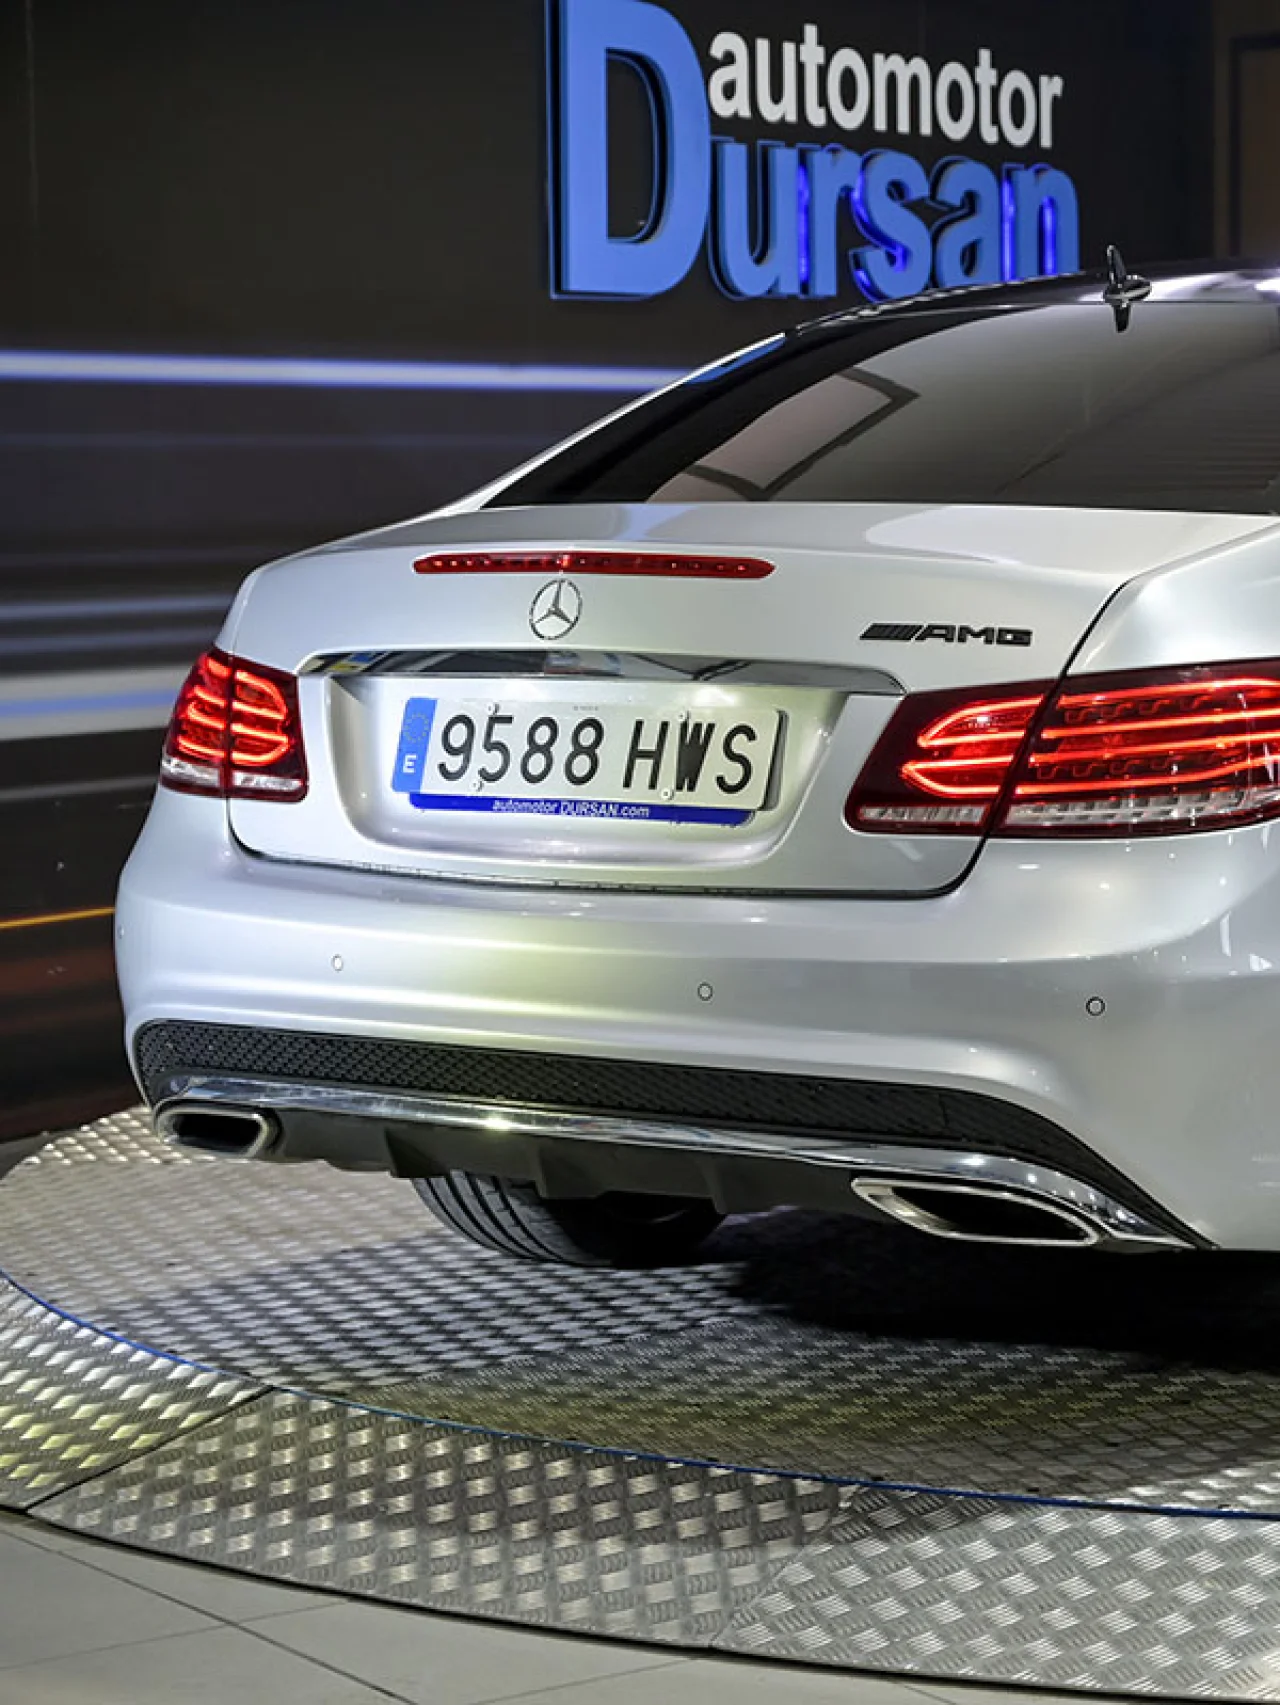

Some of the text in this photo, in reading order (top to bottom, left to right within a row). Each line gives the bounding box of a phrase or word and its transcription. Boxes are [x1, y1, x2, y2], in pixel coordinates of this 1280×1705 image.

[708, 22, 1064, 149] automotor
[546, 0, 1080, 300] Dursan
[914, 624, 1033, 647] AMG
[402, 754, 417, 774] E
[436, 713, 758, 795] 9588 HWS
[493, 799, 650, 819] automotor DURSAN.com
